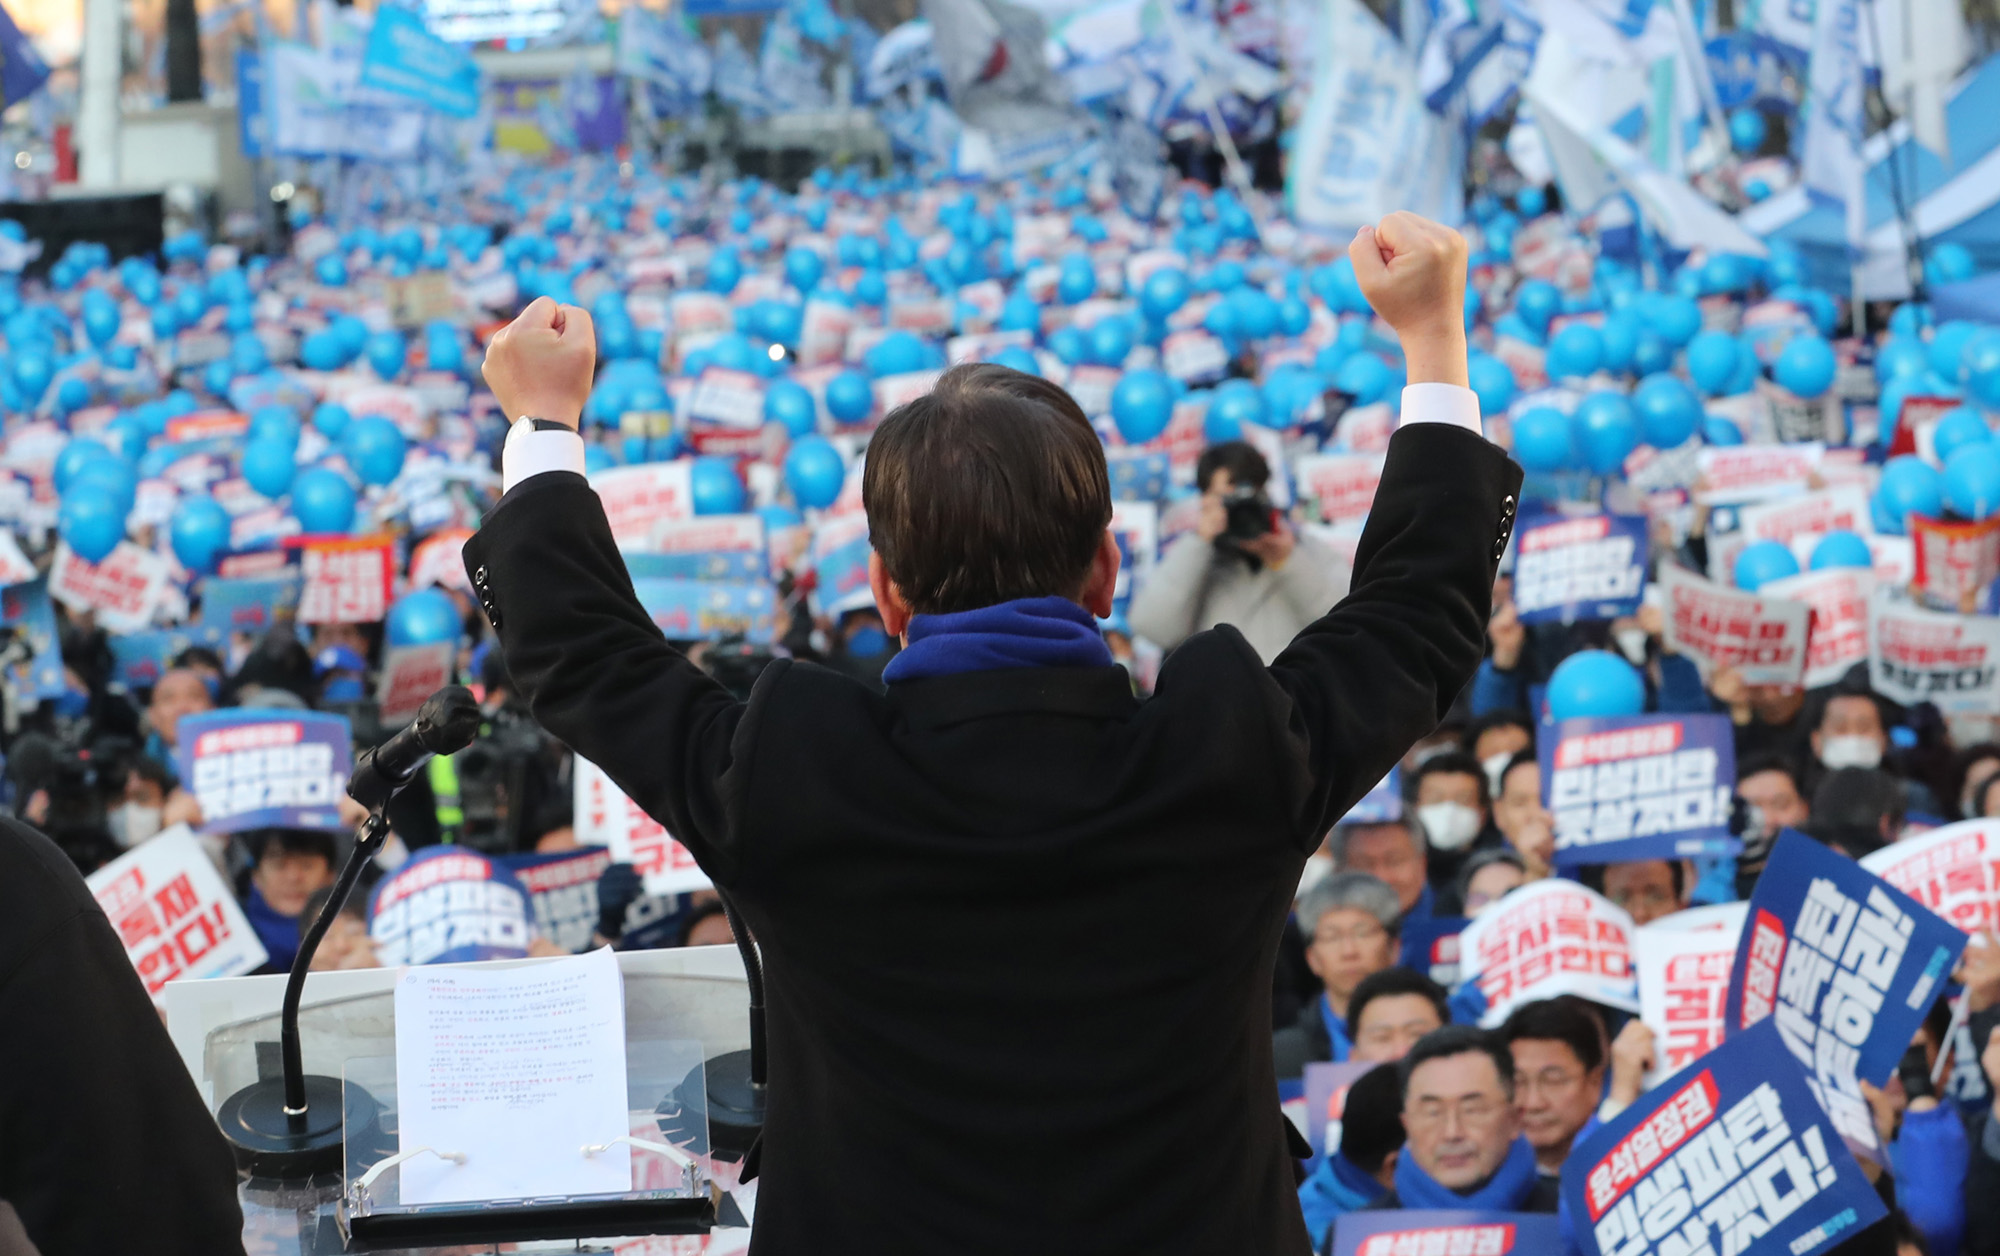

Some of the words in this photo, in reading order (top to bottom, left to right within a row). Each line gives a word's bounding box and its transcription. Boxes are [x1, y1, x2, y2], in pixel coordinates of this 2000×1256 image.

[1551, 747, 1718, 810] 민생파탄
[1553, 785, 1731, 850] 못살겠다!
[119, 872, 200, 948] 독재
[137, 902, 231, 994] 한다!
[1775, 877, 1860, 1069] 가폭탄
[1588, 1080, 1712, 1211] 윤석열정권
[1594, 1081, 1792, 1256] 민생파탄
[1642, 1124, 1838, 1256] 살겠다!
